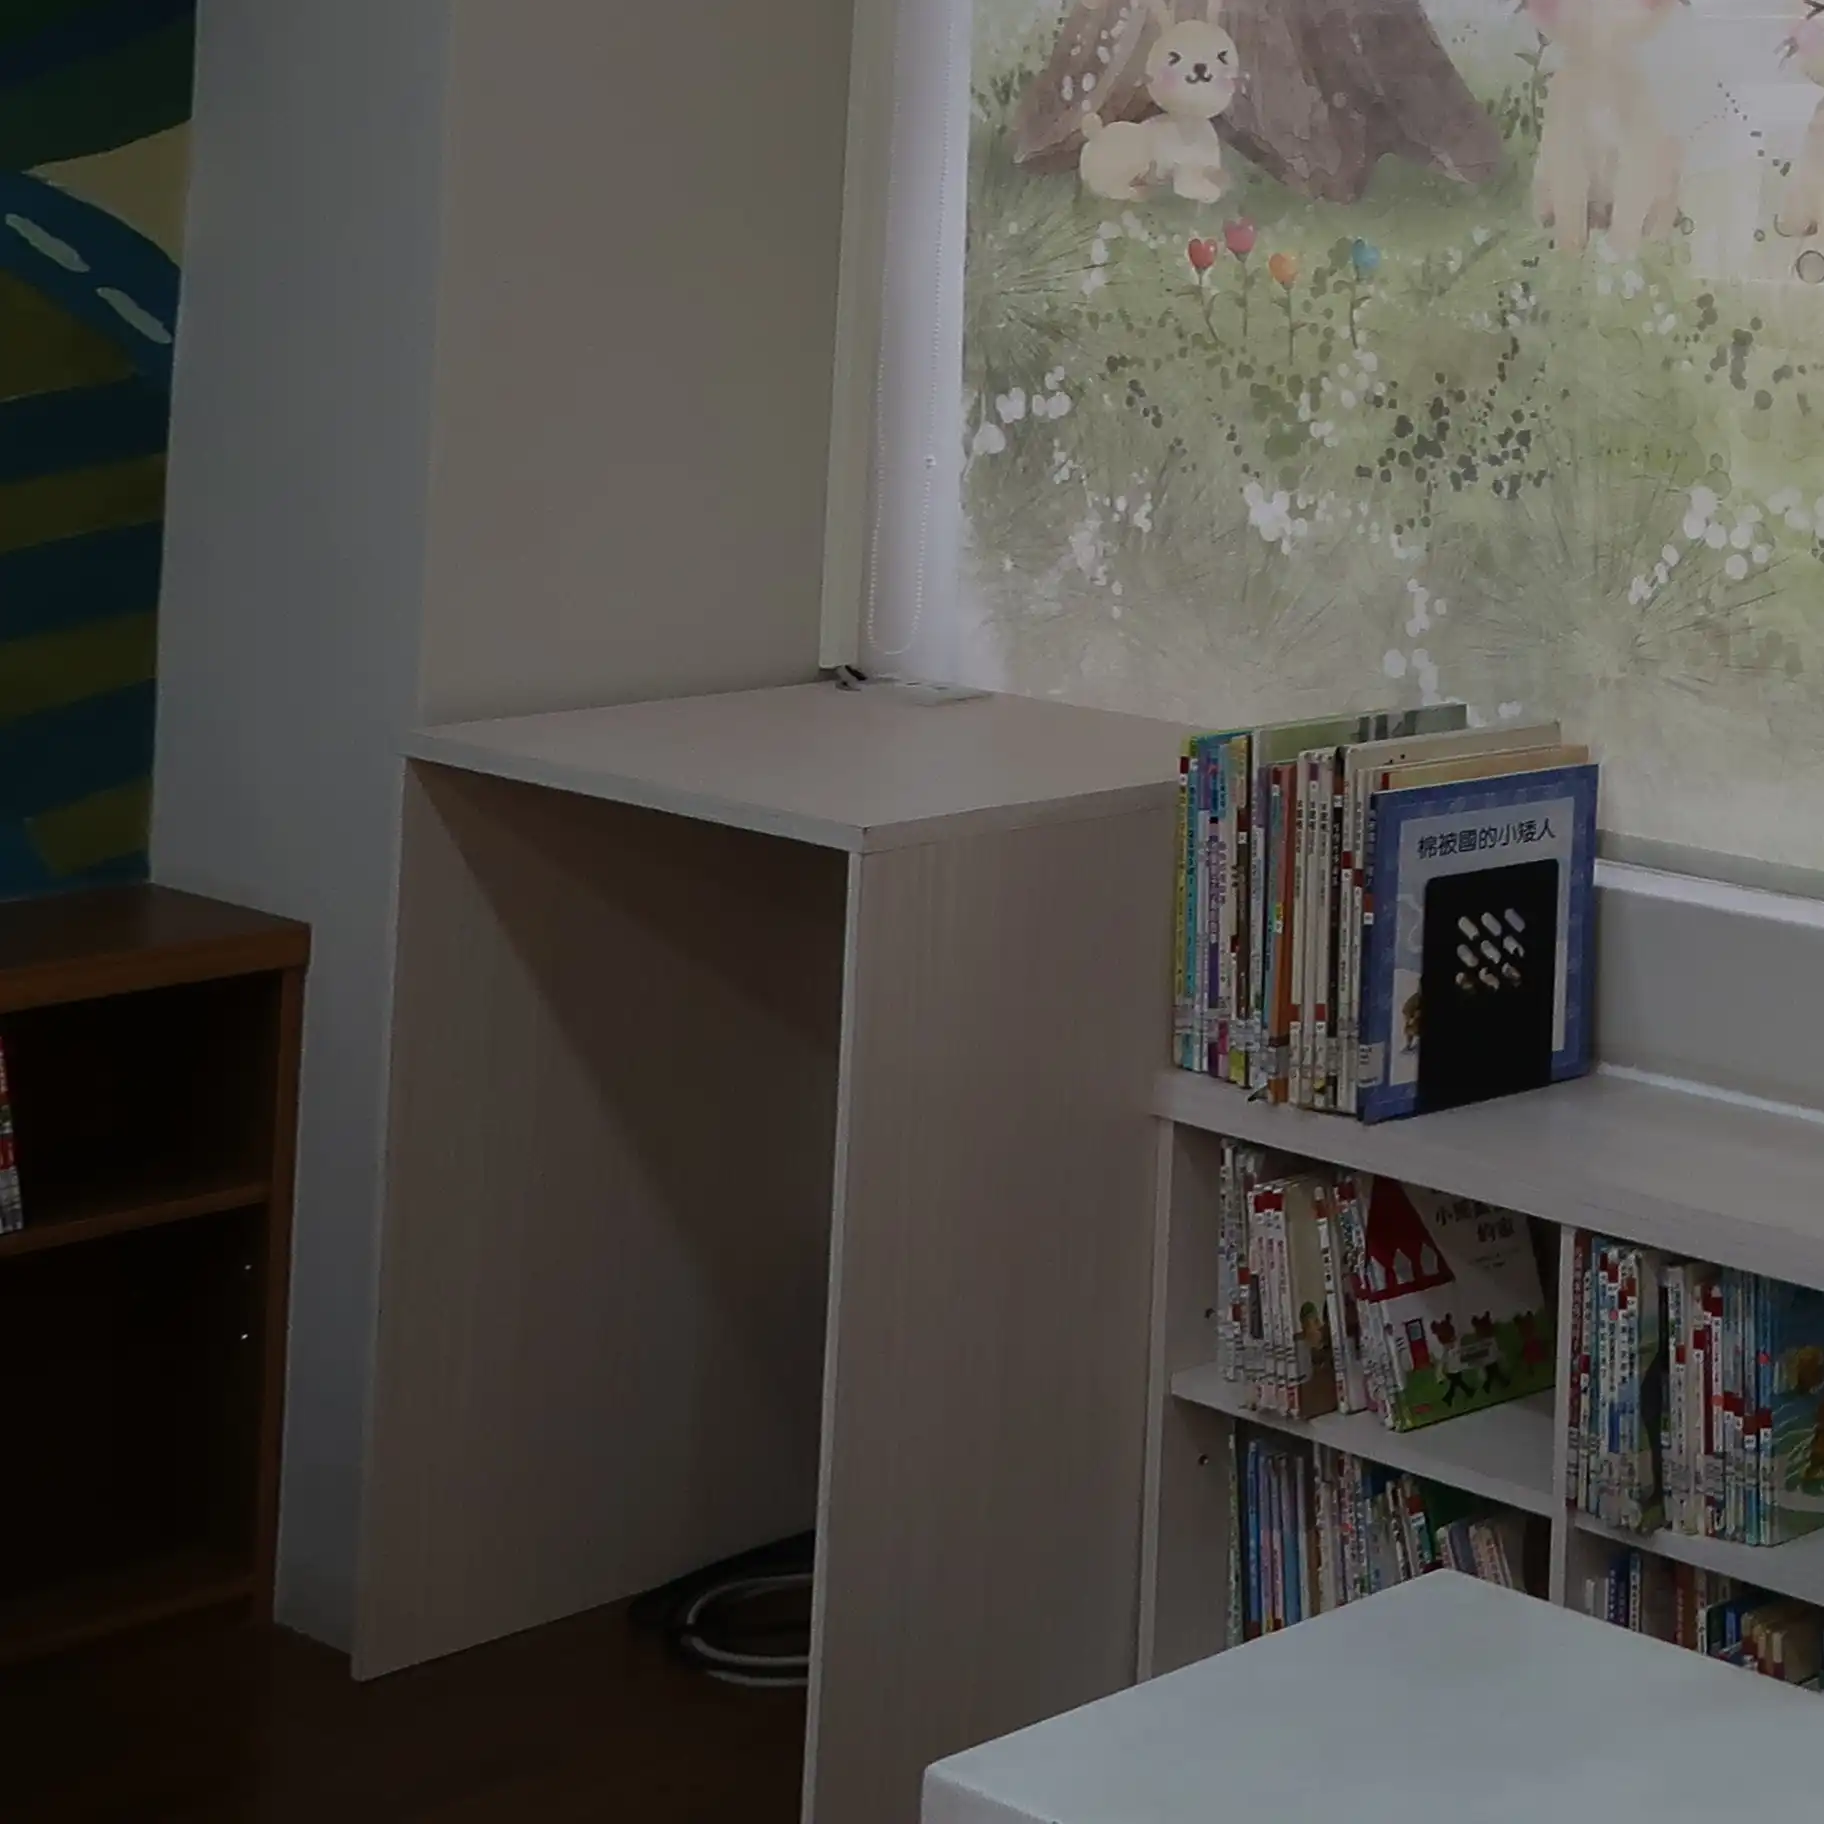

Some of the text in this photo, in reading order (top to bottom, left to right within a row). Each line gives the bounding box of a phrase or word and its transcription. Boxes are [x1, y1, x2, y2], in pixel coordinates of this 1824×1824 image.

[1417, 817, 1556, 860] 棉被國的小矮人
